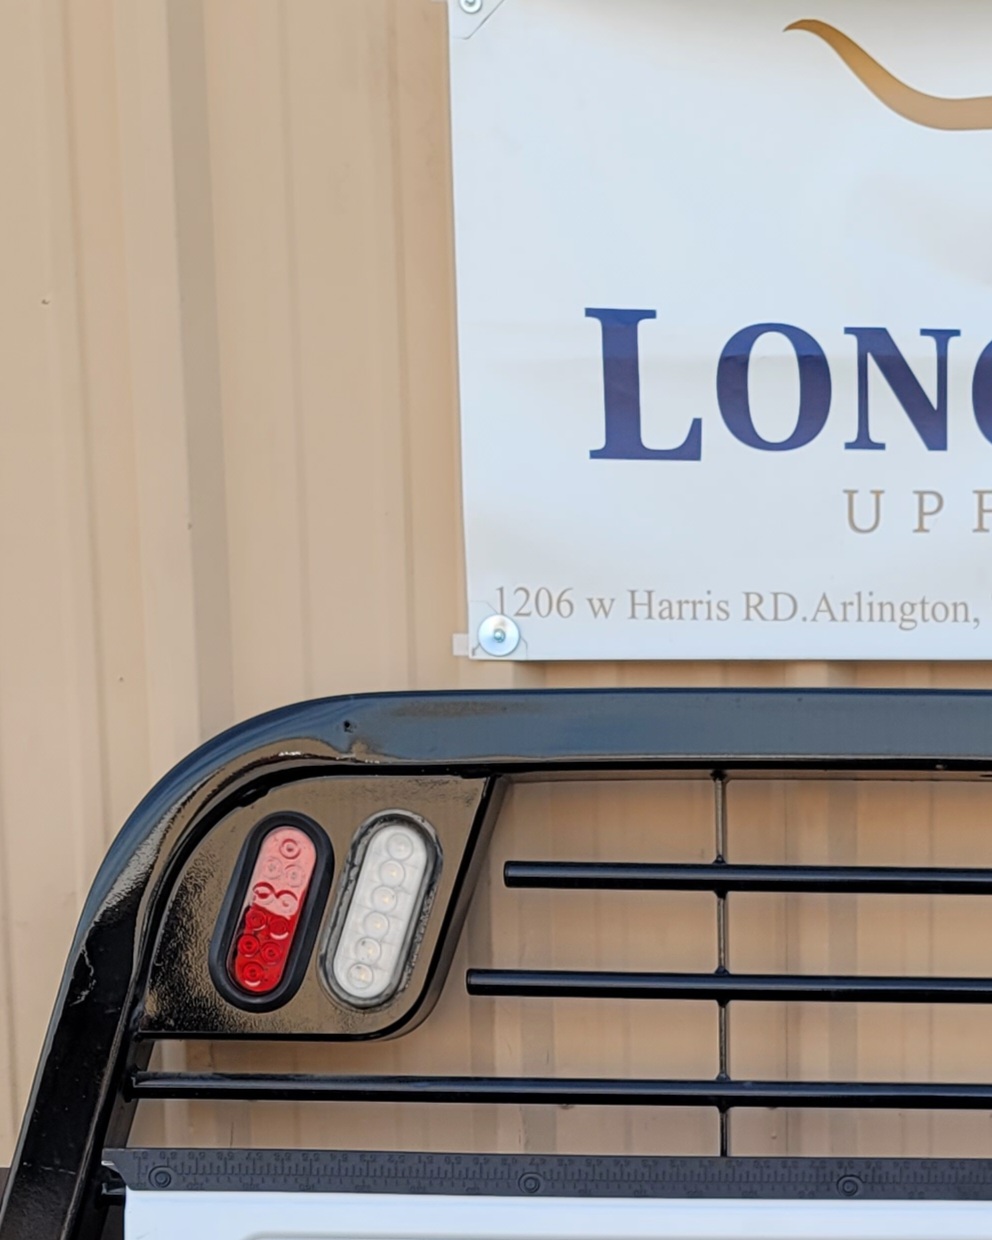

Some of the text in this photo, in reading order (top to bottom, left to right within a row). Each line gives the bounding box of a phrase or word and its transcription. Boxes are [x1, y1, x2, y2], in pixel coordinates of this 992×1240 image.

[496, 586, 574, 619] 1206
[586, 598, 616, 619] w
[627, 589, 730, 622] Harris
